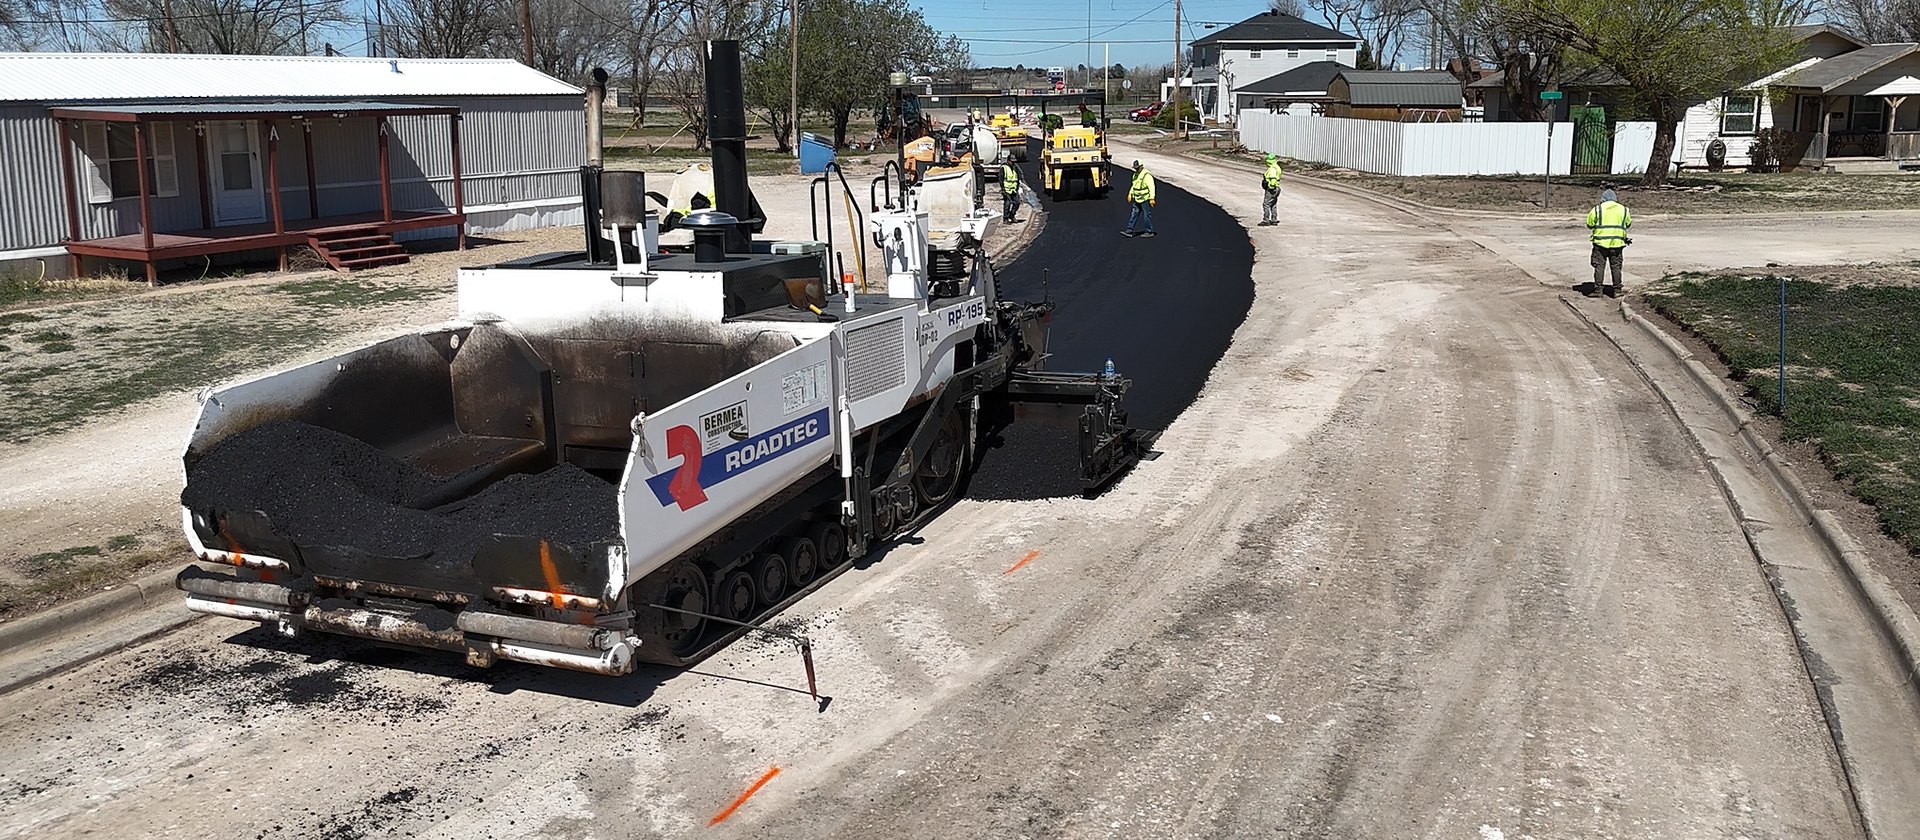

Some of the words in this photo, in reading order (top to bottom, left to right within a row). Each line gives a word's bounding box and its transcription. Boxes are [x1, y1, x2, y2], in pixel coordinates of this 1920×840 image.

[948, 302, 983, 327] RP-195
[704, 405, 744, 431] BERMEA
[725, 418, 818, 473] ROADTEC
